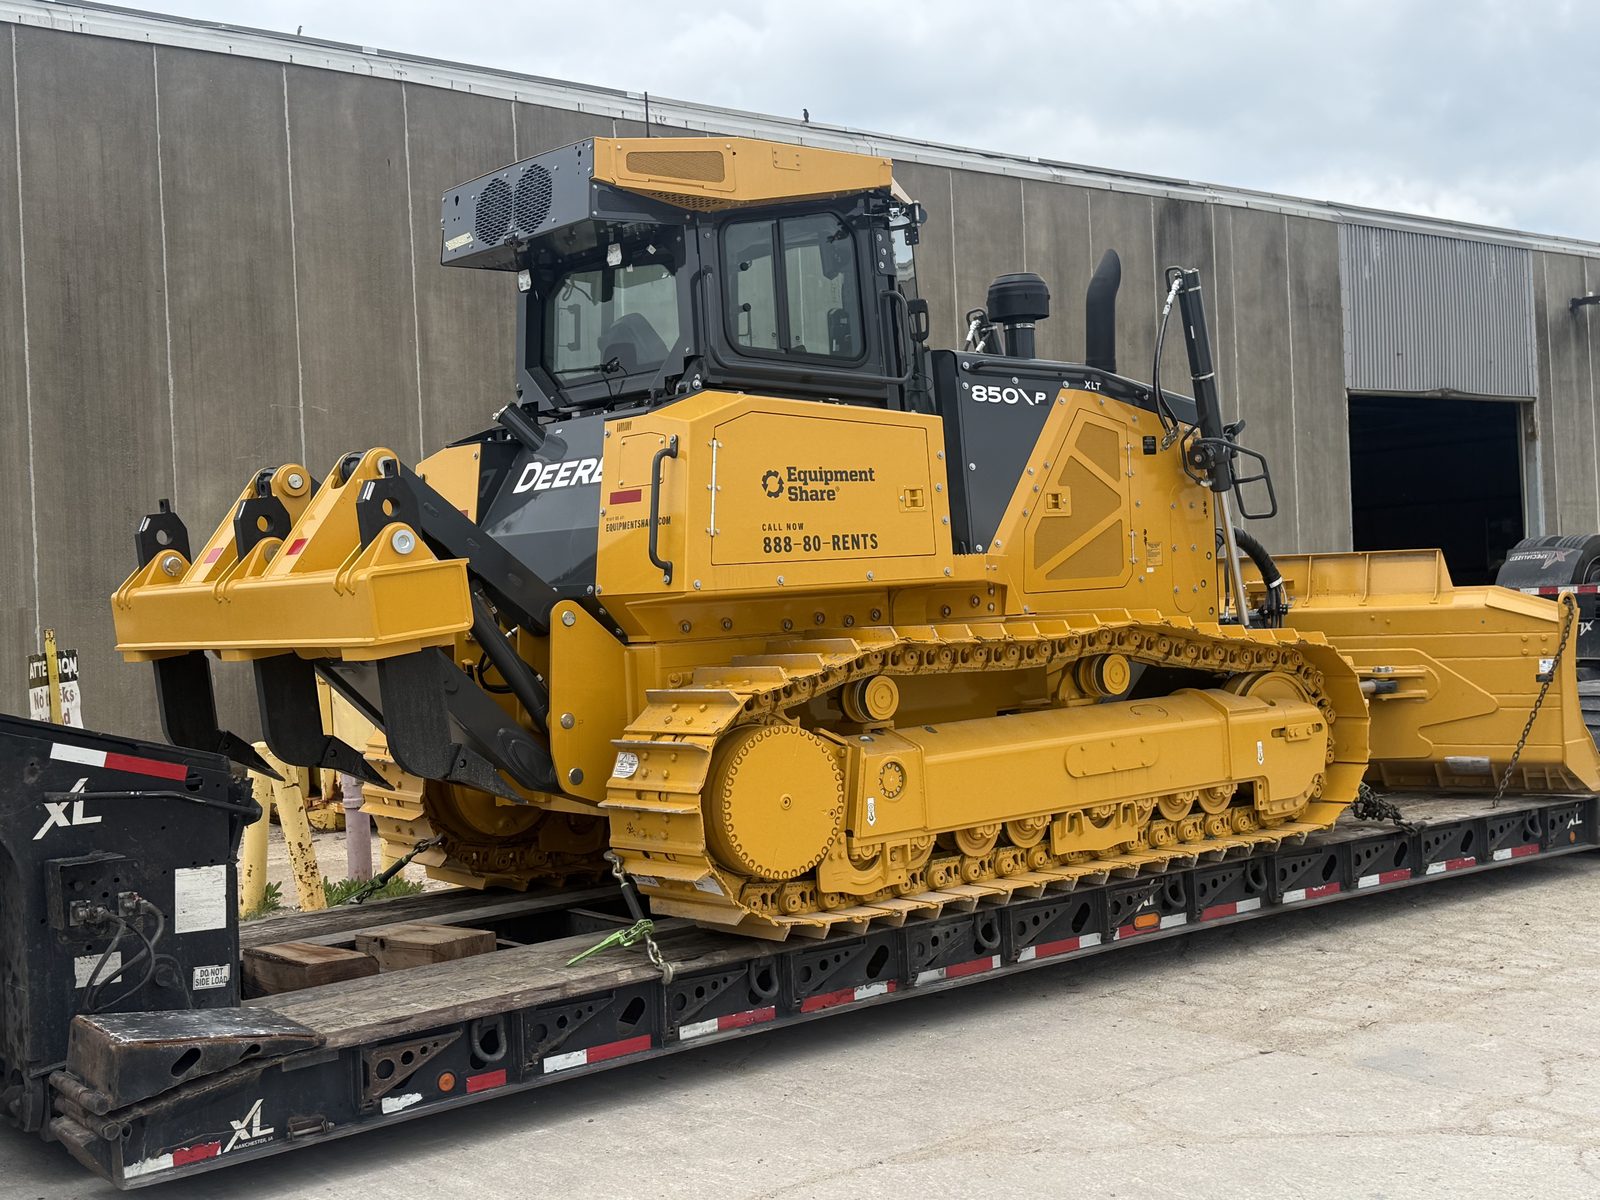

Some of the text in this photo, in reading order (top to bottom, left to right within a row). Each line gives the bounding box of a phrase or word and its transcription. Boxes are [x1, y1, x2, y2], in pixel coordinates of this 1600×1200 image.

[1084, 380, 1102, 391] XLT
[786, 466, 875, 485] Equipment
[606, 516, 671, 532] EQUIPMENTSHACOM
[762, 522, 804, 531] CALL NOW
[763, 533, 878, 553] 888-80-RENTS
[29, 656, 78, 680] ATTEION
[33, 691, 44, 711] No
[32, 777, 103, 841] XL
[195, 976, 228, 987] SIDE LOAD
[200, 968, 224, 977] DO NOT
[222, 1098, 275, 1153] XL
